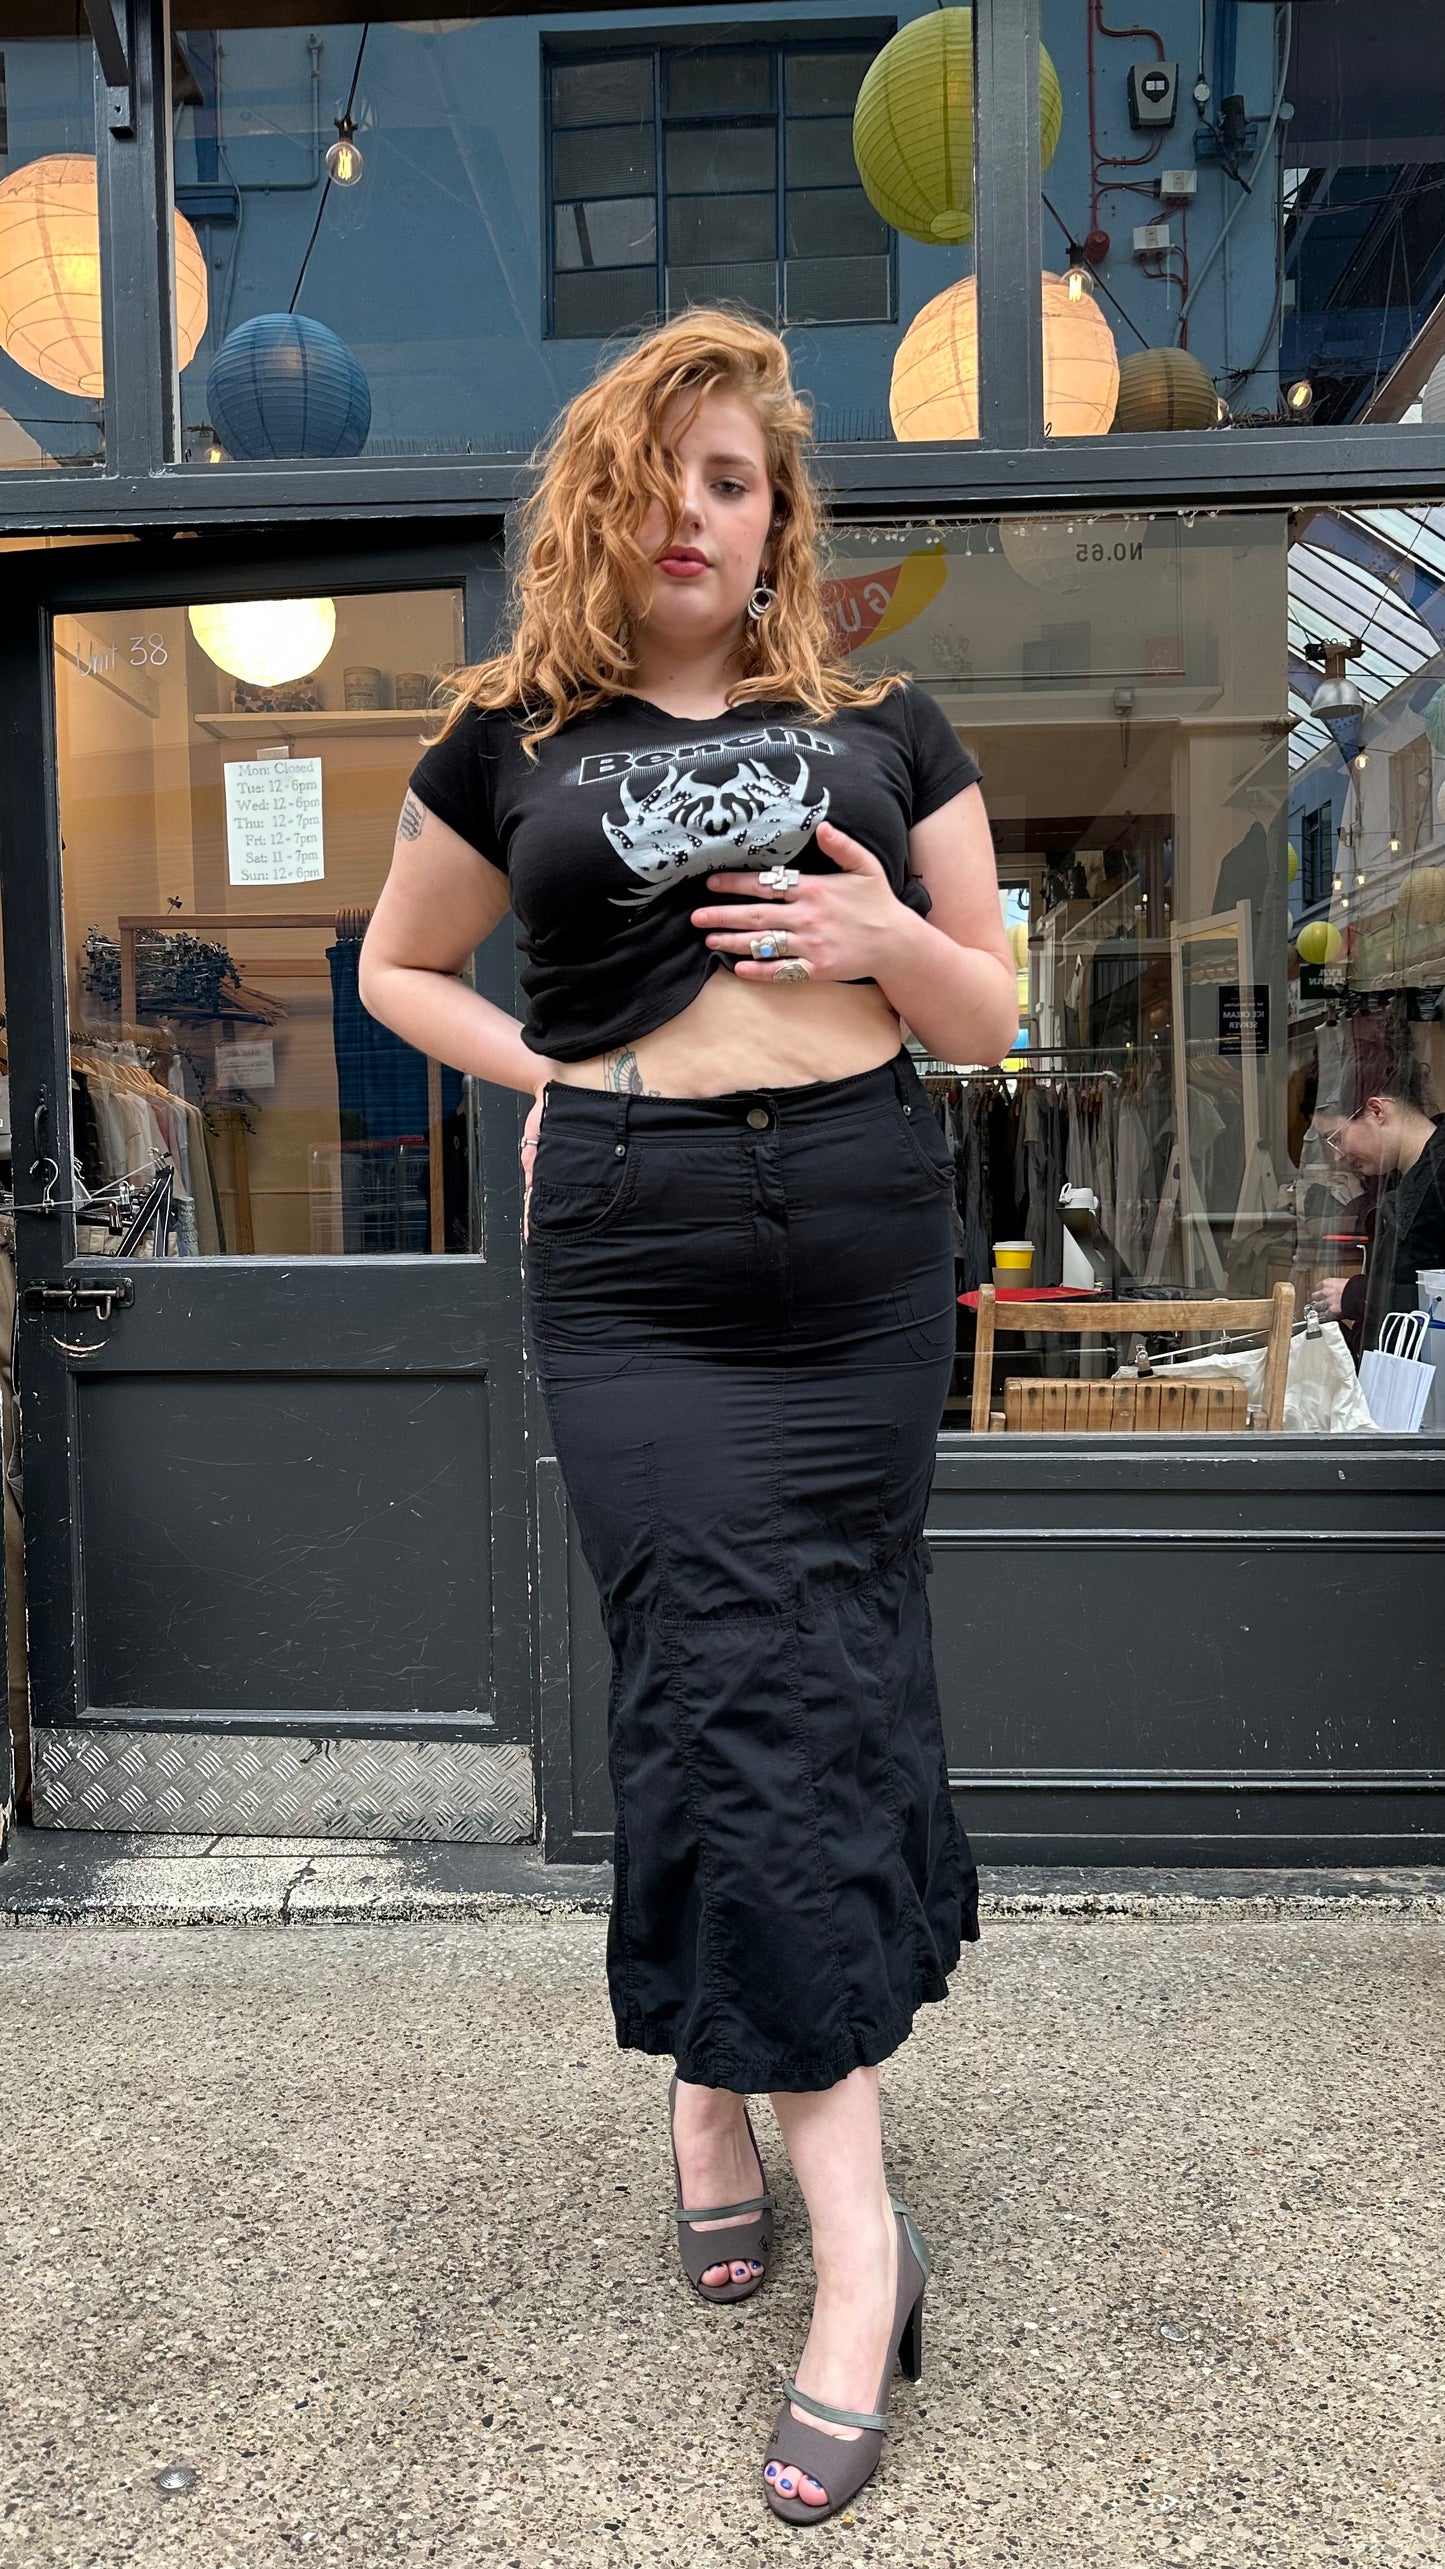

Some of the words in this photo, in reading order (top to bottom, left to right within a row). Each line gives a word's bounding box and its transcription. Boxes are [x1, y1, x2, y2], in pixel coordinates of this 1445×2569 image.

[76, 641, 118, 677] Unit
[130, 633, 168, 666] 38
[238, 764, 270, 777] Mon:
[274, 762, 314, 775] Closed
[237, 782, 264, 794] Tue:
[236, 799, 270, 811] Wed:
[233, 817, 264, 829] Thu:
[245, 834, 266, 846] Fri:
[245, 851, 268, 864] Sat:
[241, 869, 269, 881] Sun:
